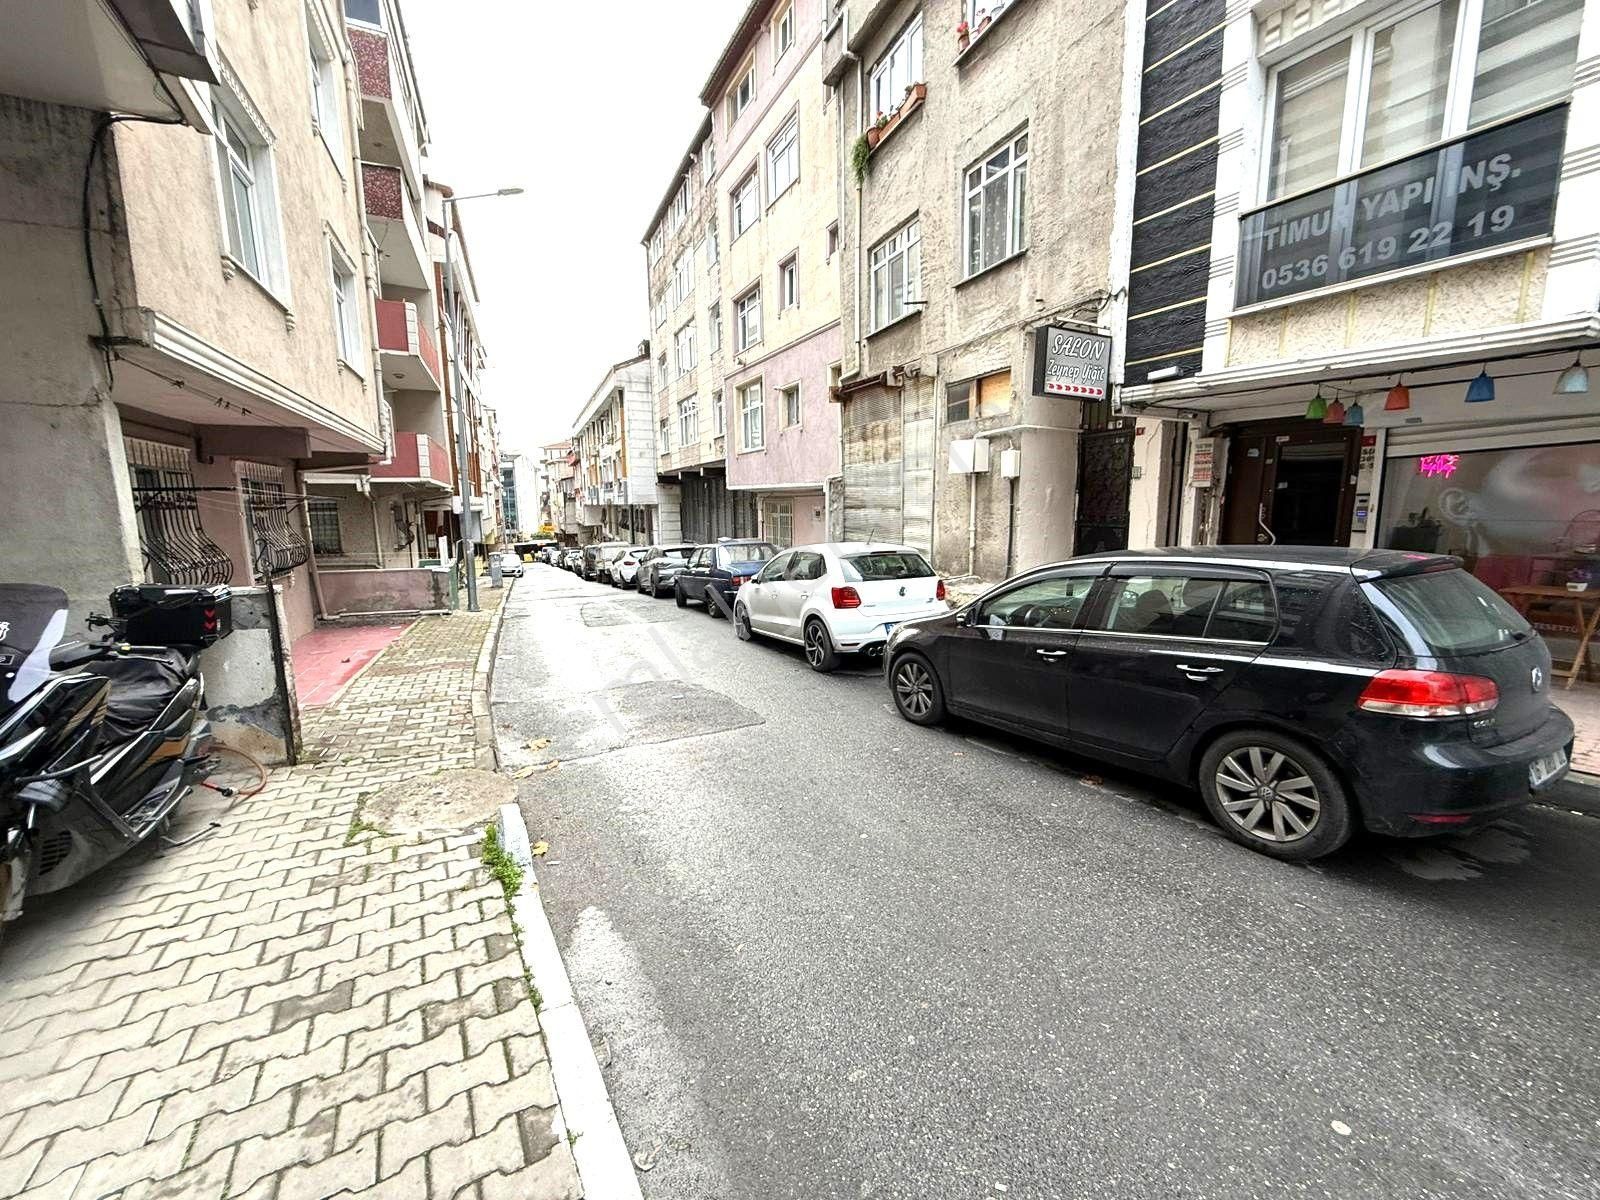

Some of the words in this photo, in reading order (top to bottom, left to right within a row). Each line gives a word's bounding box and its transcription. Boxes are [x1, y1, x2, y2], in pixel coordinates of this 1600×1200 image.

[1361, 177, 1435, 221] YAPI
[1262, 254, 1329, 290] 0536
[1338, 236, 1397, 271] 619
[1407, 220, 1454, 254] 22
[1467, 205, 1515, 238] 19
[1052, 333, 1105, 360] SALON
[1047, 359, 1080, 382] Zeynep
[1082, 364, 1105, 385] Yiğit
